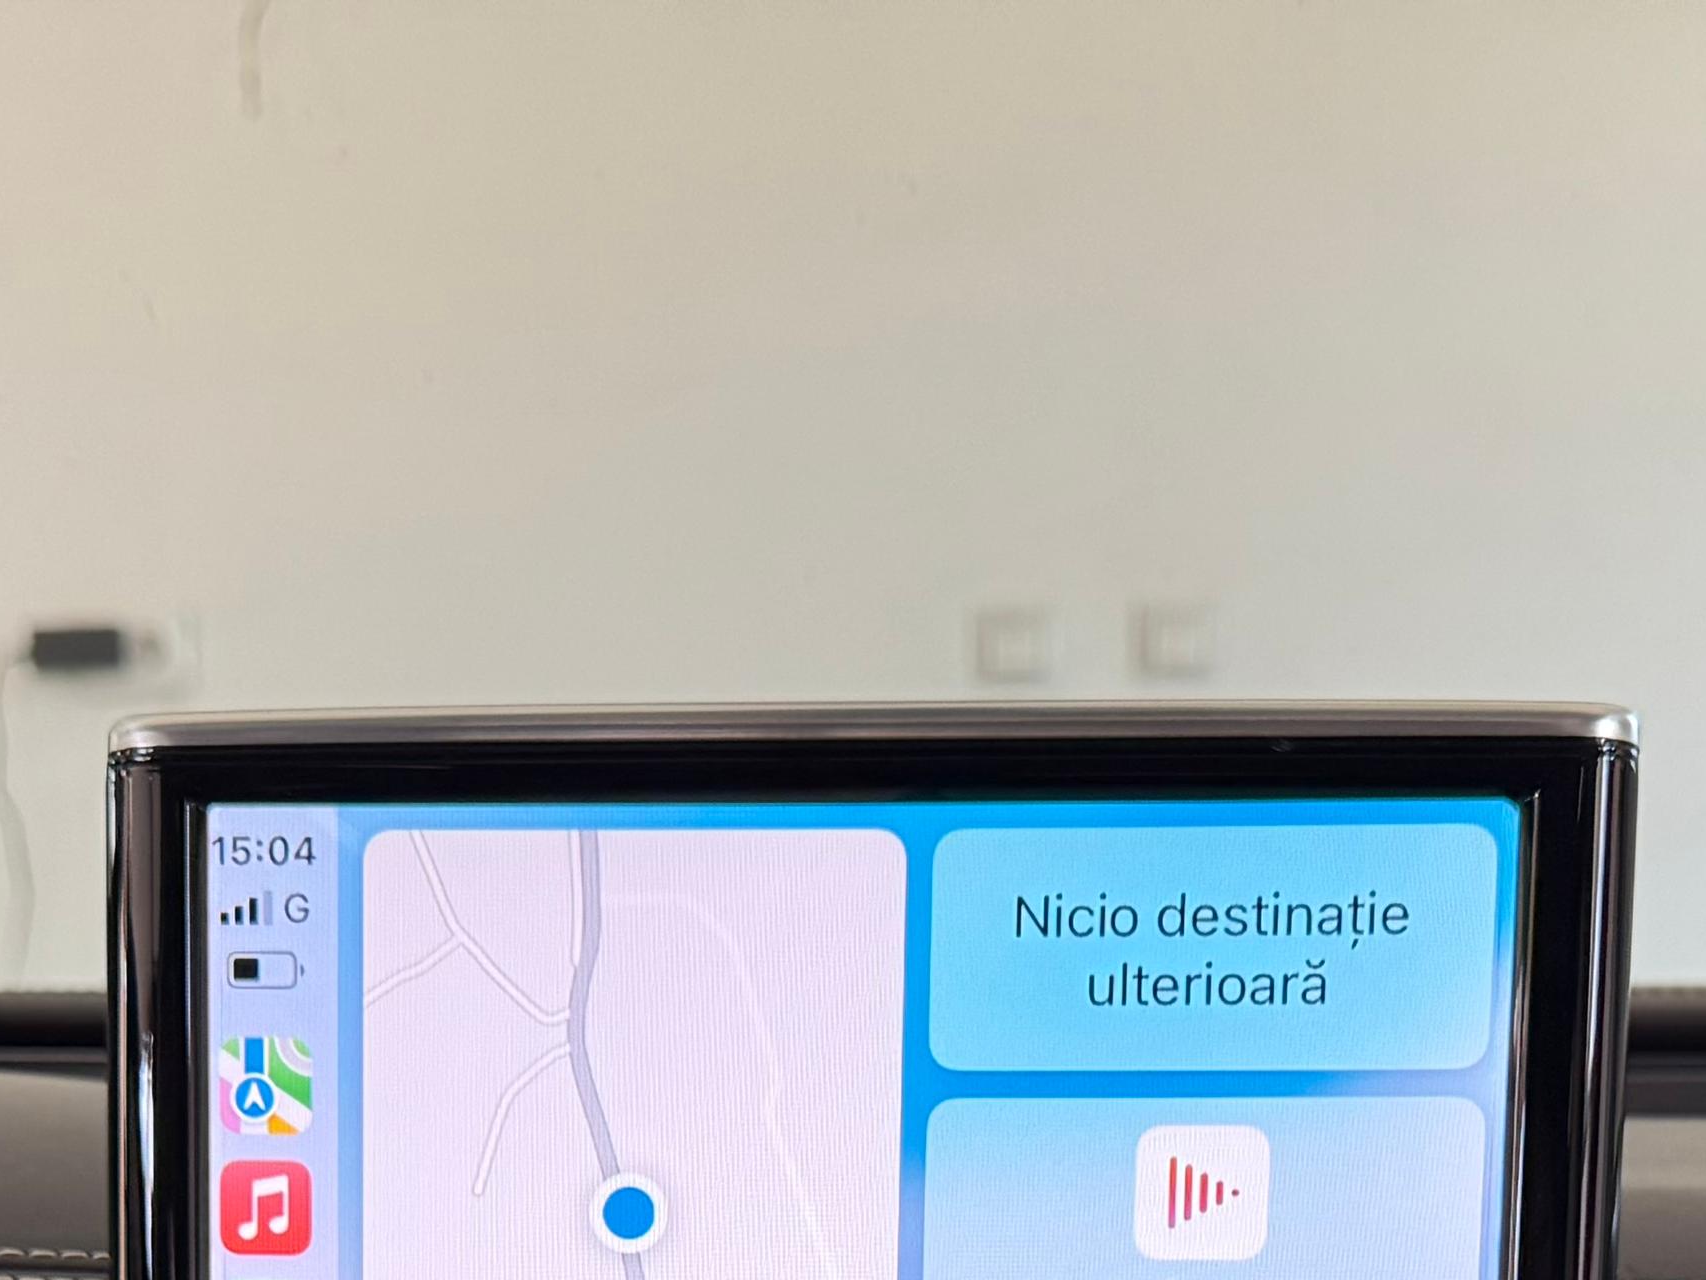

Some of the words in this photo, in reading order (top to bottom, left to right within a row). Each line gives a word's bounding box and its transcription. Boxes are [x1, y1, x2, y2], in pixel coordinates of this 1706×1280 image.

[211, 835, 317, 866] 15:04
[283, 893, 311, 924] G
[1013, 893, 1140, 940] Nicio
[1156, 891, 1411, 950] destinație
[1087, 960, 1329, 1008] ulterioară
